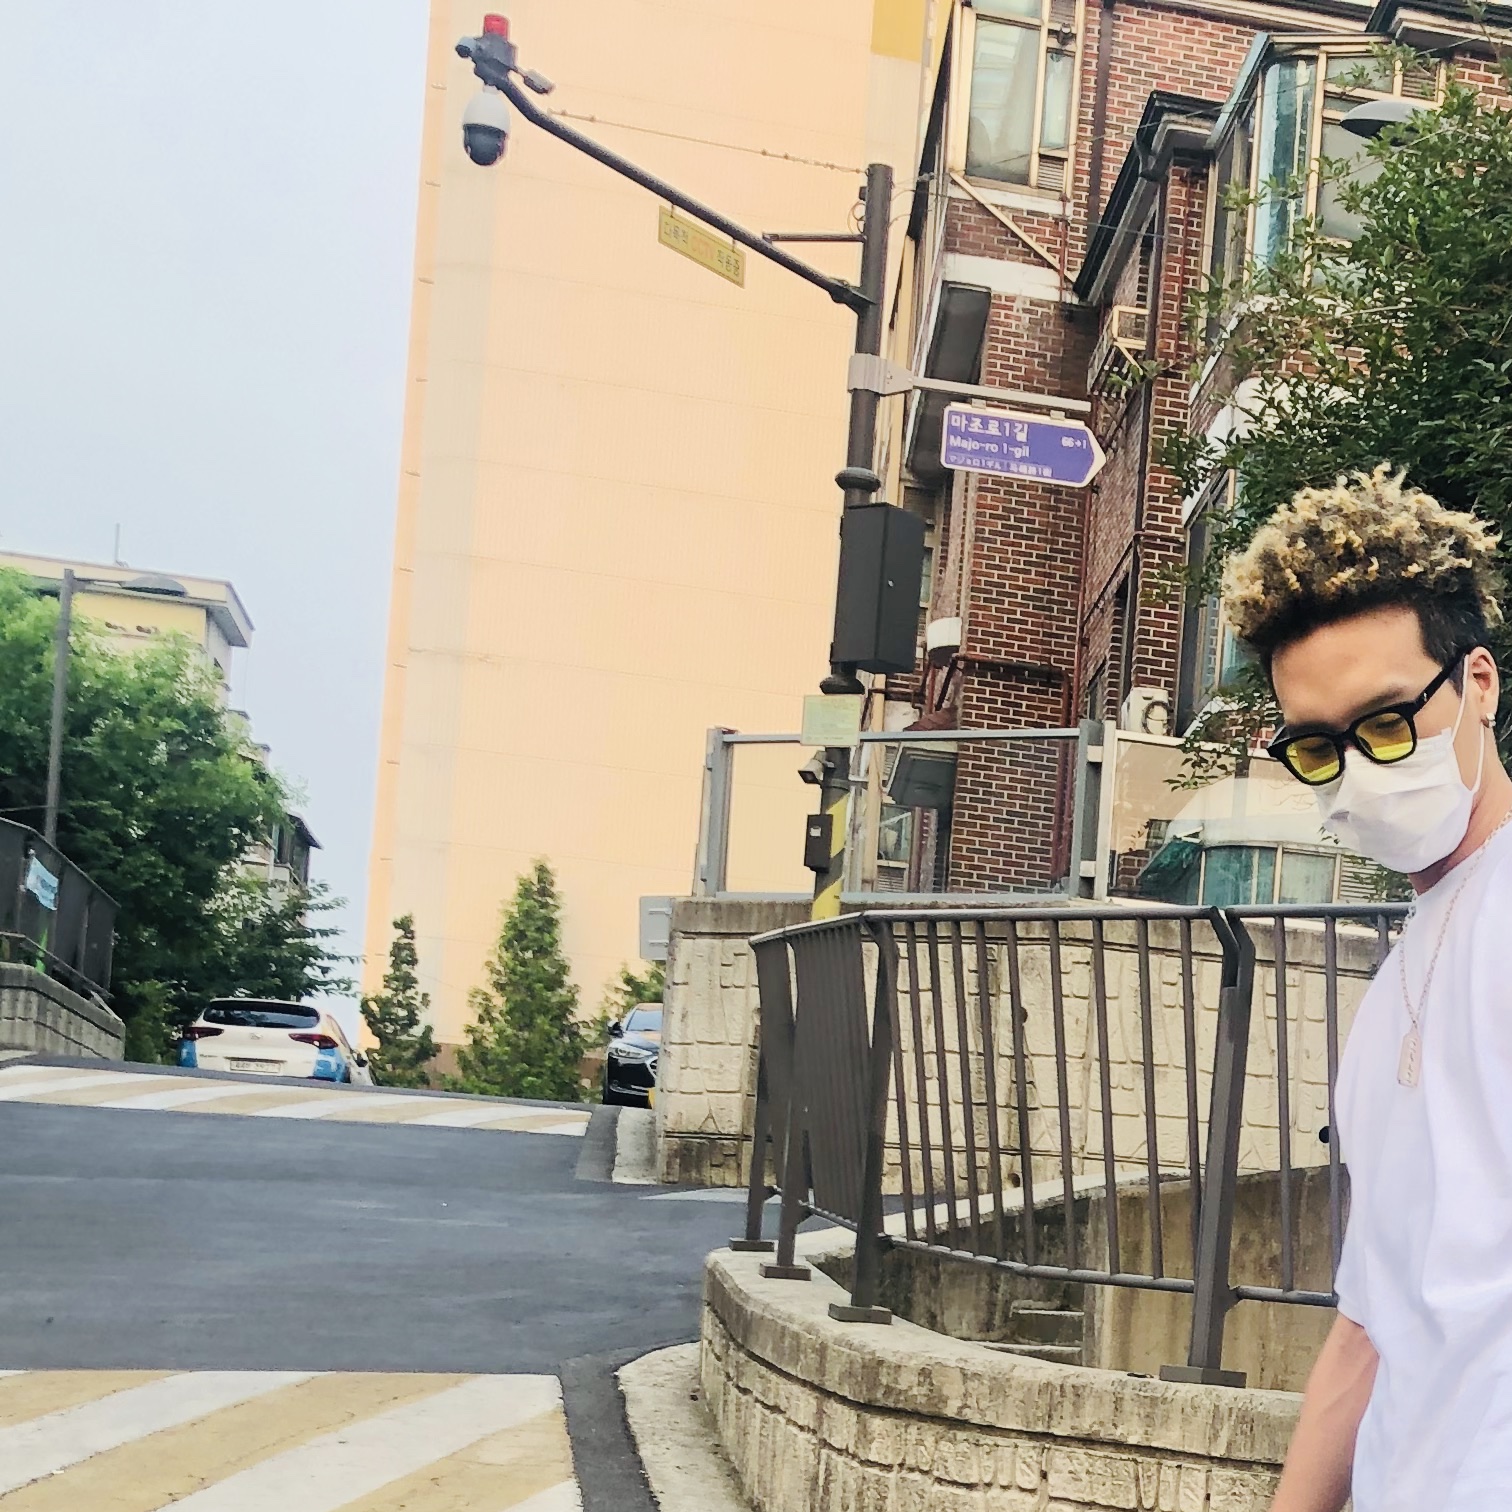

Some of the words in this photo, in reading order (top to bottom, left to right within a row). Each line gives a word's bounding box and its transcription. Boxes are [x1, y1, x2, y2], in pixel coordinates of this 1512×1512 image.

[951, 414, 1029, 443] 마조로1길
[950, 434, 999, 454] Majo-ro
[1003, 441, 1030, 459] 1-gil
